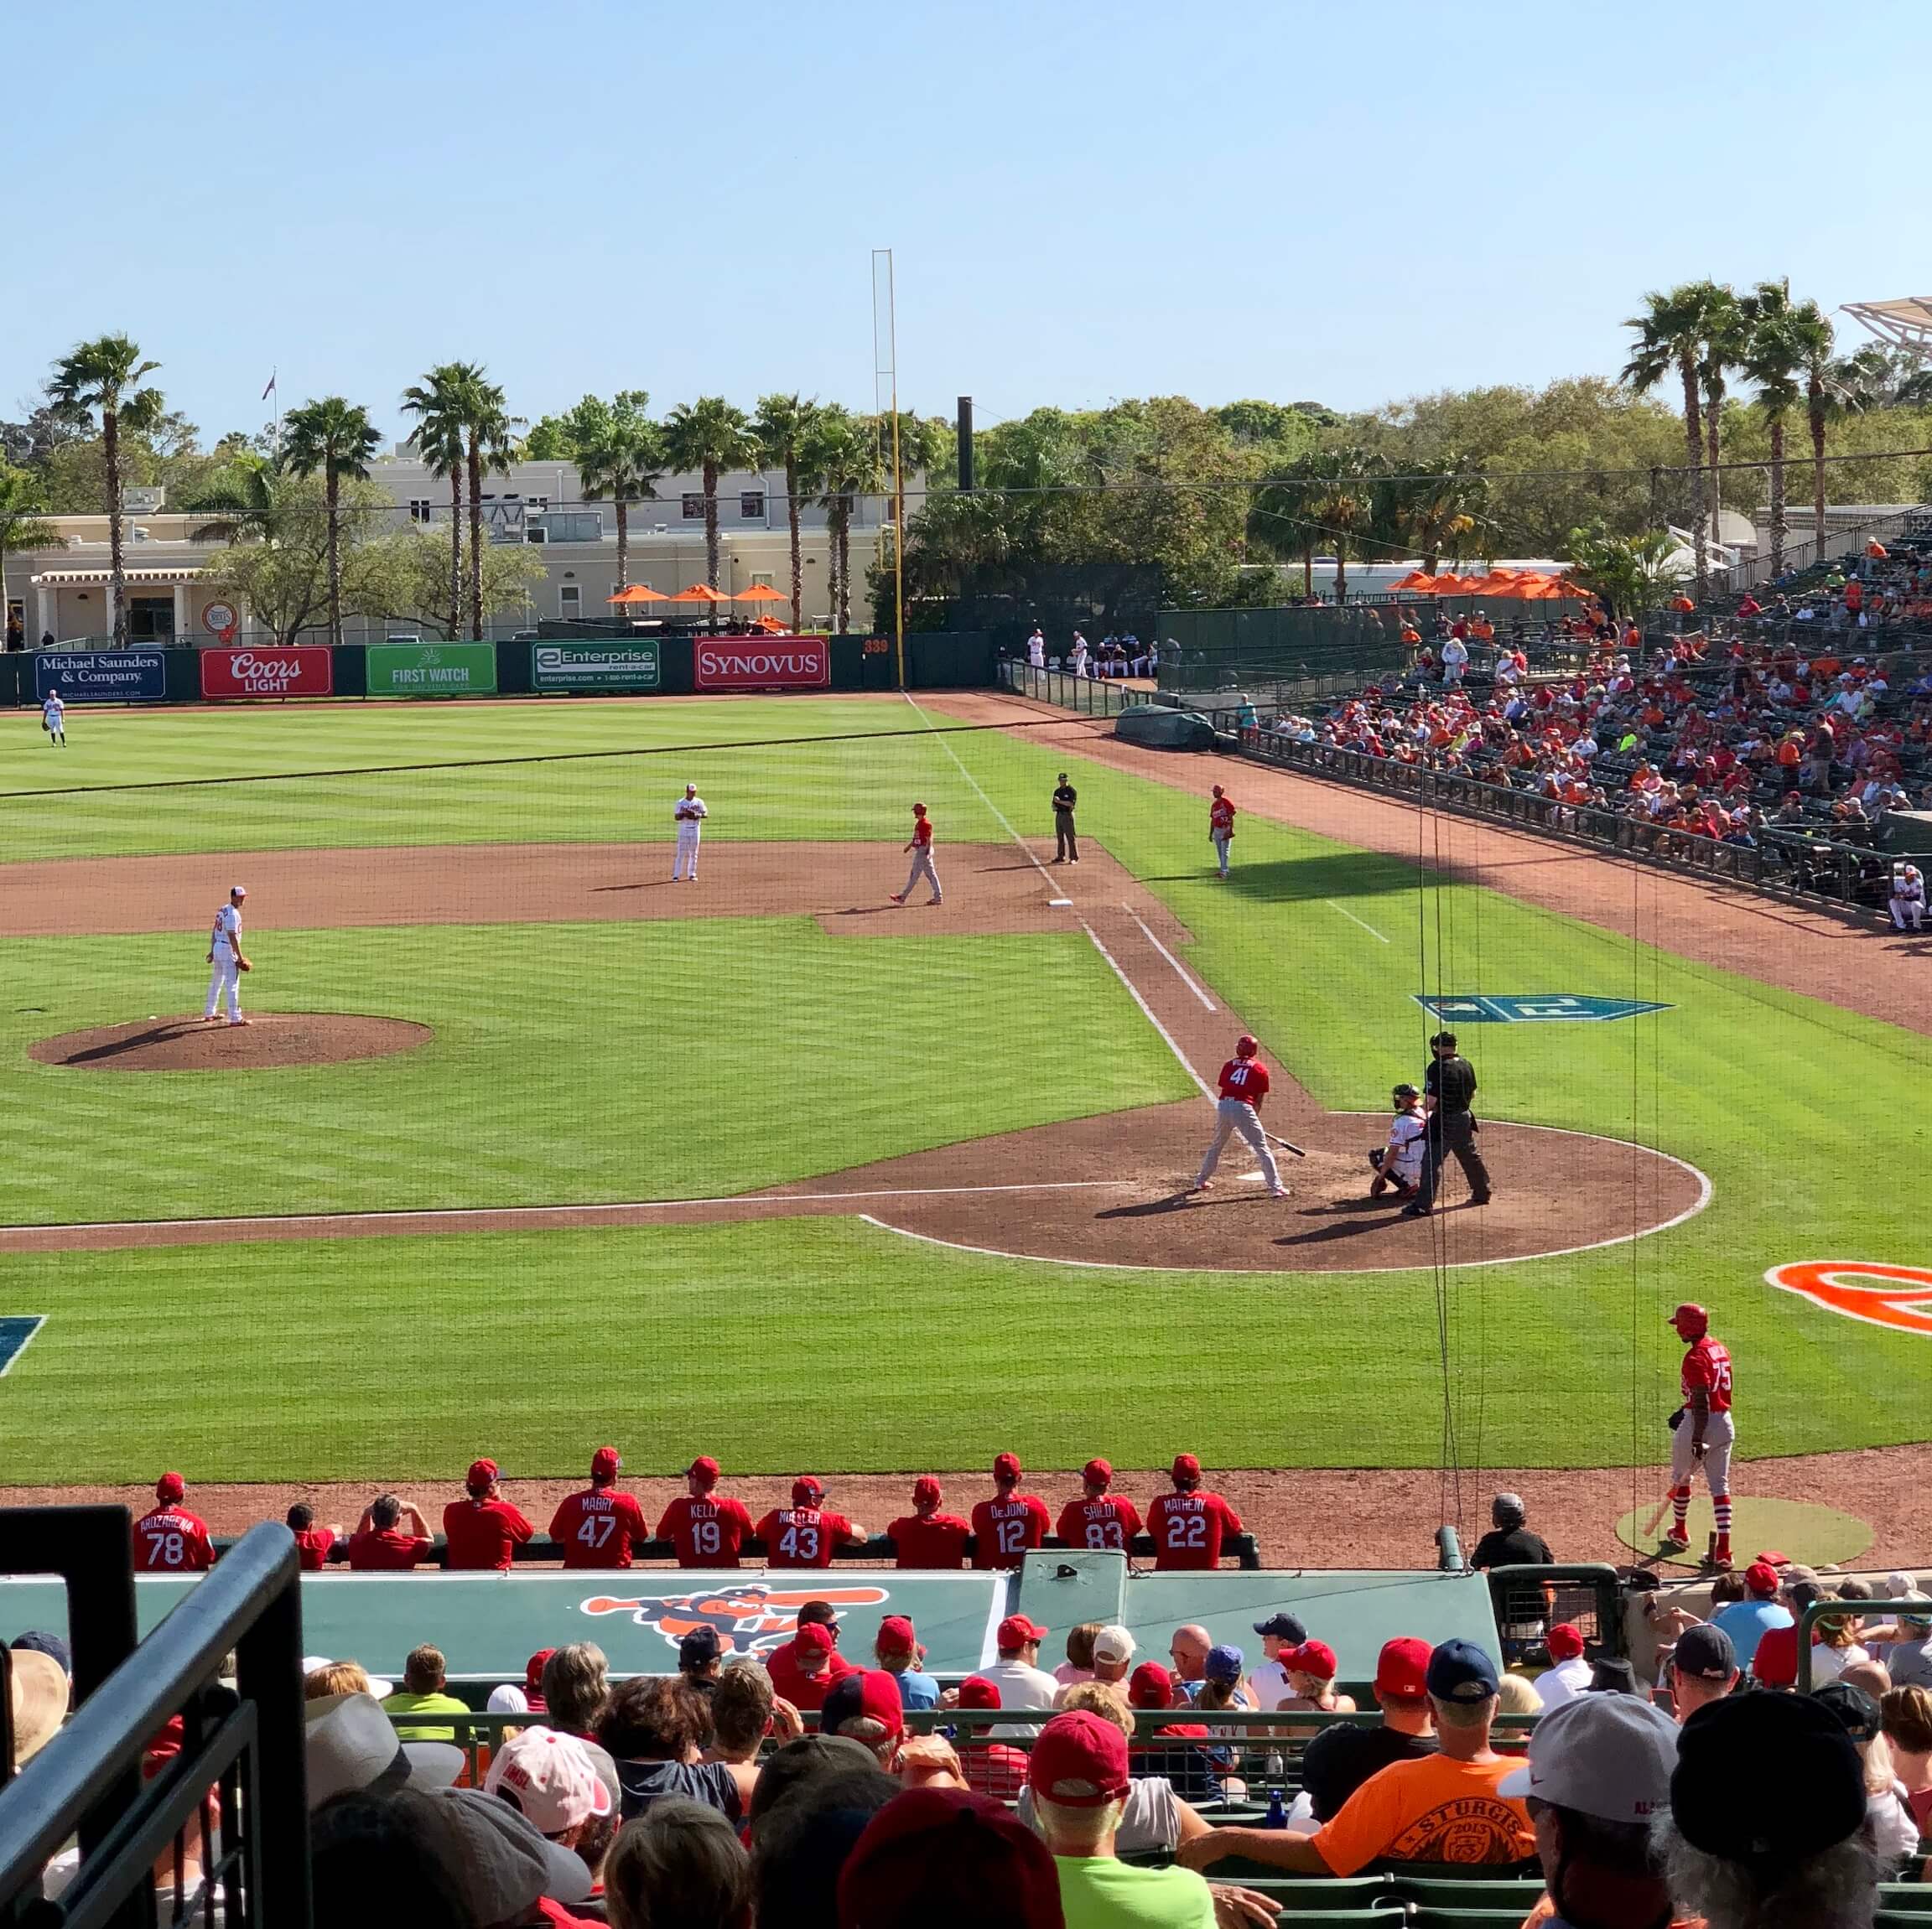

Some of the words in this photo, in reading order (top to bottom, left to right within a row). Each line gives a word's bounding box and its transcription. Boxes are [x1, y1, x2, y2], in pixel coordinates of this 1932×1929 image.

[42, 656, 95, 670] Michael
[98, 656, 158, 669] Saunders
[230, 653, 303, 679] Coors
[563, 649, 653, 664] Enterprise
[701, 652, 818, 675] SYNOVUS
[60, 671, 74, 682] &
[392, 669, 426, 683] FIRST
[429, 667, 470, 682] WATCH
[539, 675, 594, 683] enterprise.com
[244, 678, 289, 692] LIGHT
[1230, 1067, 1249, 1086] 41
[1711, 1361, 1732, 1392] 75
[582, 1496, 615, 1512] MABRY
[690, 1503, 720, 1518] KELLY
[1083, 1502, 1117, 1521] SHILDT
[1164, 1497, 1207, 1513] MATHENY
[140, 1515, 195, 1533] AROZARENA
[779, 1511, 820, 1525] MUELLER
[577, 1516, 616, 1548] 47
[692, 1522, 720, 1554] 19
[996, 1520, 1026, 1553] 12
[1085, 1522, 1124, 1549] 83
[1166, 1516, 1206, 1548] 22
[147, 1532, 184, 1565] 78
[780, 1527, 818, 1559] 43
[1418, 1801, 1521, 1835] STURGIS
